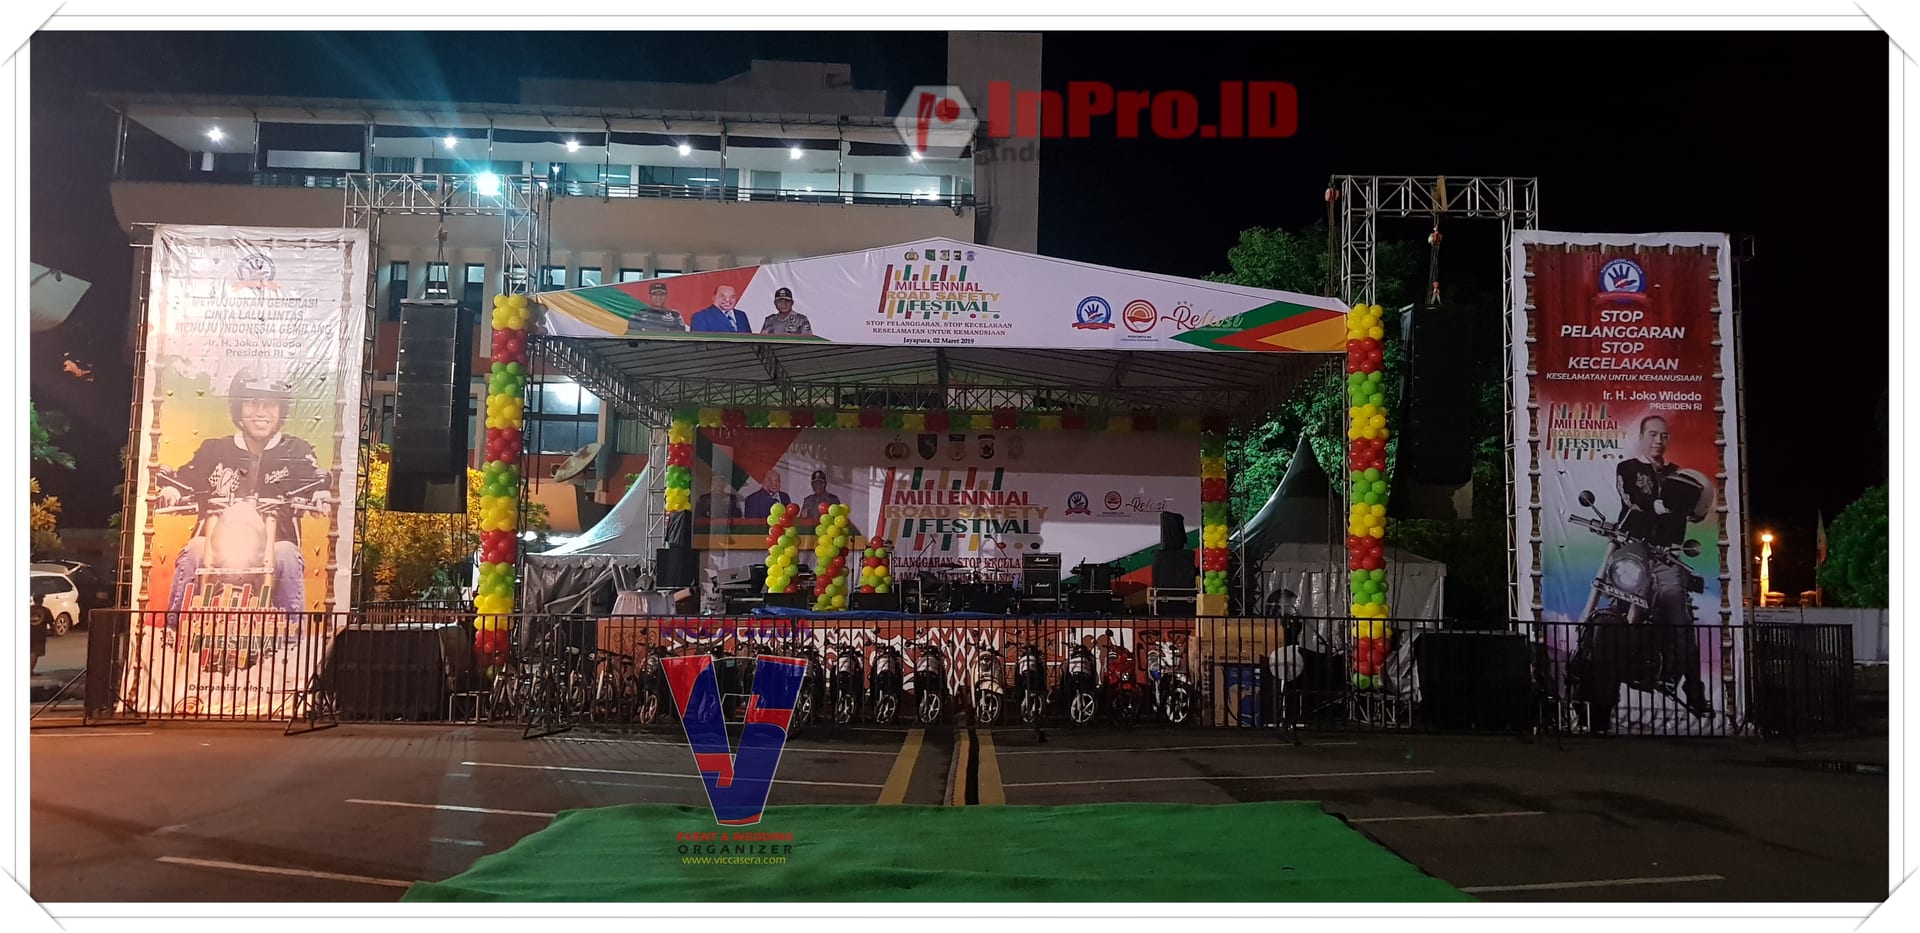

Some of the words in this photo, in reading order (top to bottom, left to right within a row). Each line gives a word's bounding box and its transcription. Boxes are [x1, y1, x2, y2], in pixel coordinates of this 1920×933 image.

[895, 281, 983, 292] MILLENNIAL
[886, 291, 930, 301] ROAD
[935, 291, 1000, 302] SAFETY
[908, 300, 1000, 312] FESTIVAL
[204, 310, 235, 320] CINTA
[238, 310, 264, 321] LALU
[267, 310, 304, 321] LINTAS
[1600, 310, 1644, 322] STOP
[1561, 325, 1685, 339] PELANGGARAN
[225, 349, 271, 357] Presiden
[1601, 341, 1644, 354] STOP
[1568, 357, 1679, 370] KECELAKAAN
[1546, 373, 1607, 381] KESELAMATAN
[1639, 374, 1702, 382] KEMANUSIAAN
[1615, 391, 1627, 400] H.
[1630, 391, 1657, 401] Joko
[1659, 391, 1702, 401] Widodo
[1650, 402, 1692, 411] PRESIDEN
[1693, 403, 1703, 411] RI
[1554, 419, 1618, 430] MILLENNIAL
[1551, 430, 1581, 438] ROAD
[1584, 430, 1628, 439] SAFETY
[1566, 438, 1624, 449] FESTIVAL
[894, 490, 1040, 505] MILLENNIAL
[885, 505, 951, 519] ROAD
[958, 506, 1048, 519] SAFETY
[919, 518, 1041, 534] FESTIVAL
